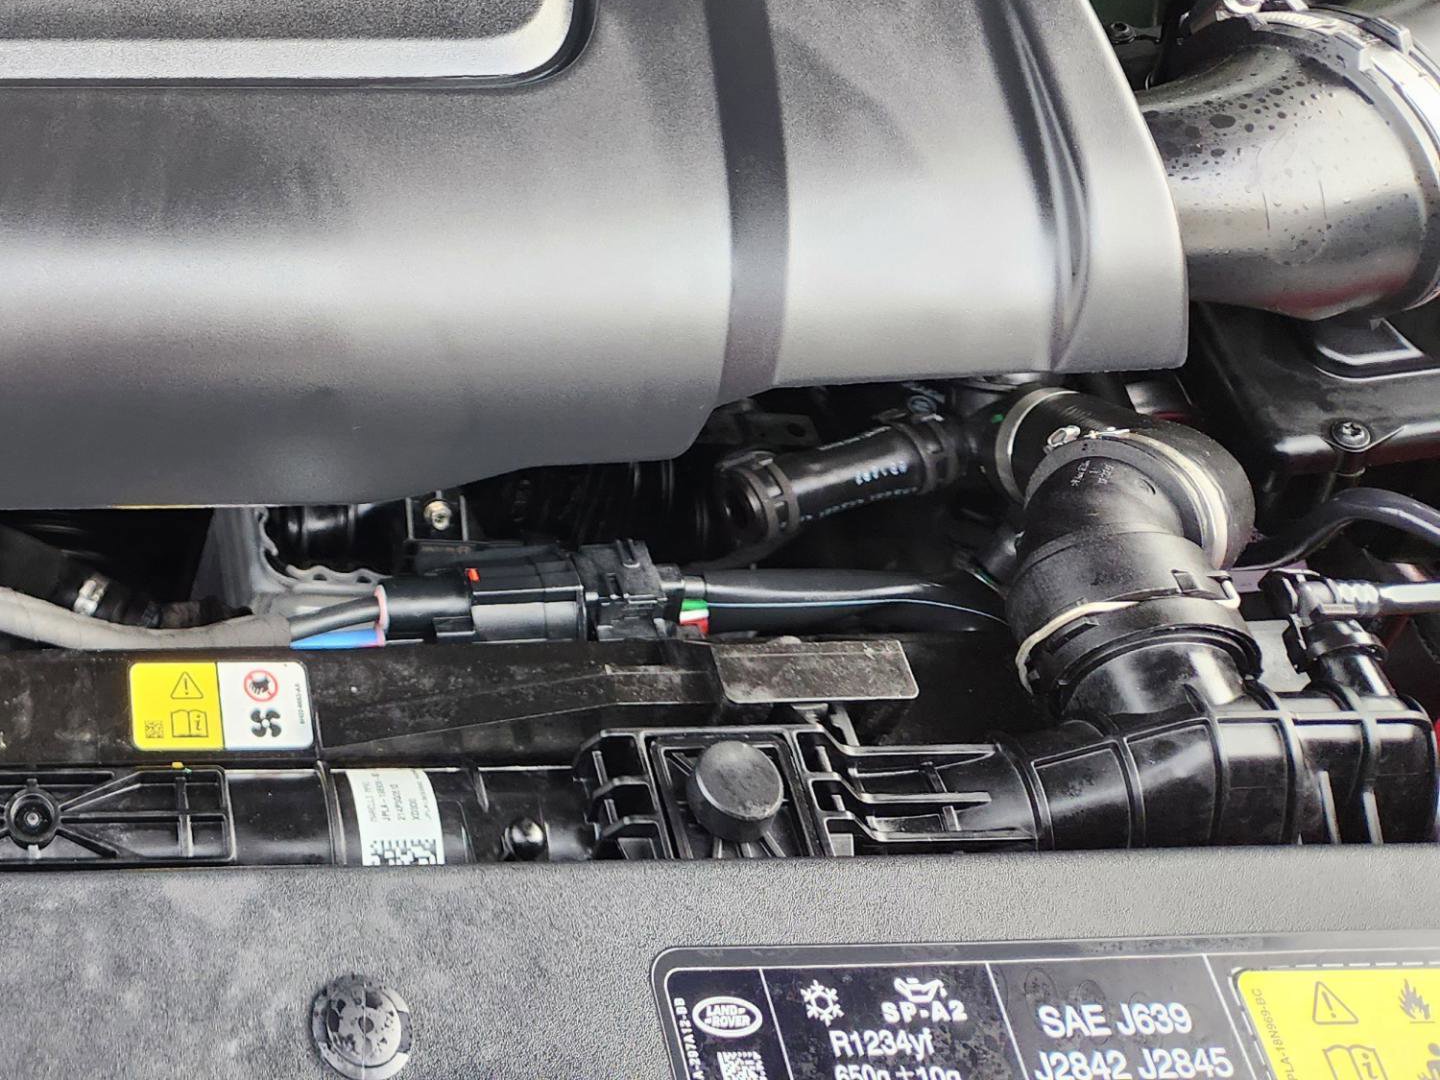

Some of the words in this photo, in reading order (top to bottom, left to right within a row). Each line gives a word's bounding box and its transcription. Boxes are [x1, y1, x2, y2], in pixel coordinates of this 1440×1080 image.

[706, 1004, 739, 1017] LAND
[710, 1015, 751, 1028] ROVER
[880, 999, 968, 1024] SP-A2
[1037, 1003, 1112, 1038] SAE
[1116, 1001, 1193, 1036] J639
[828, 1027, 936, 1062] R1234yf
[1034, 1050, 1133, 1080] J2842
[1137, 1046, 1235, 1080] J2845
